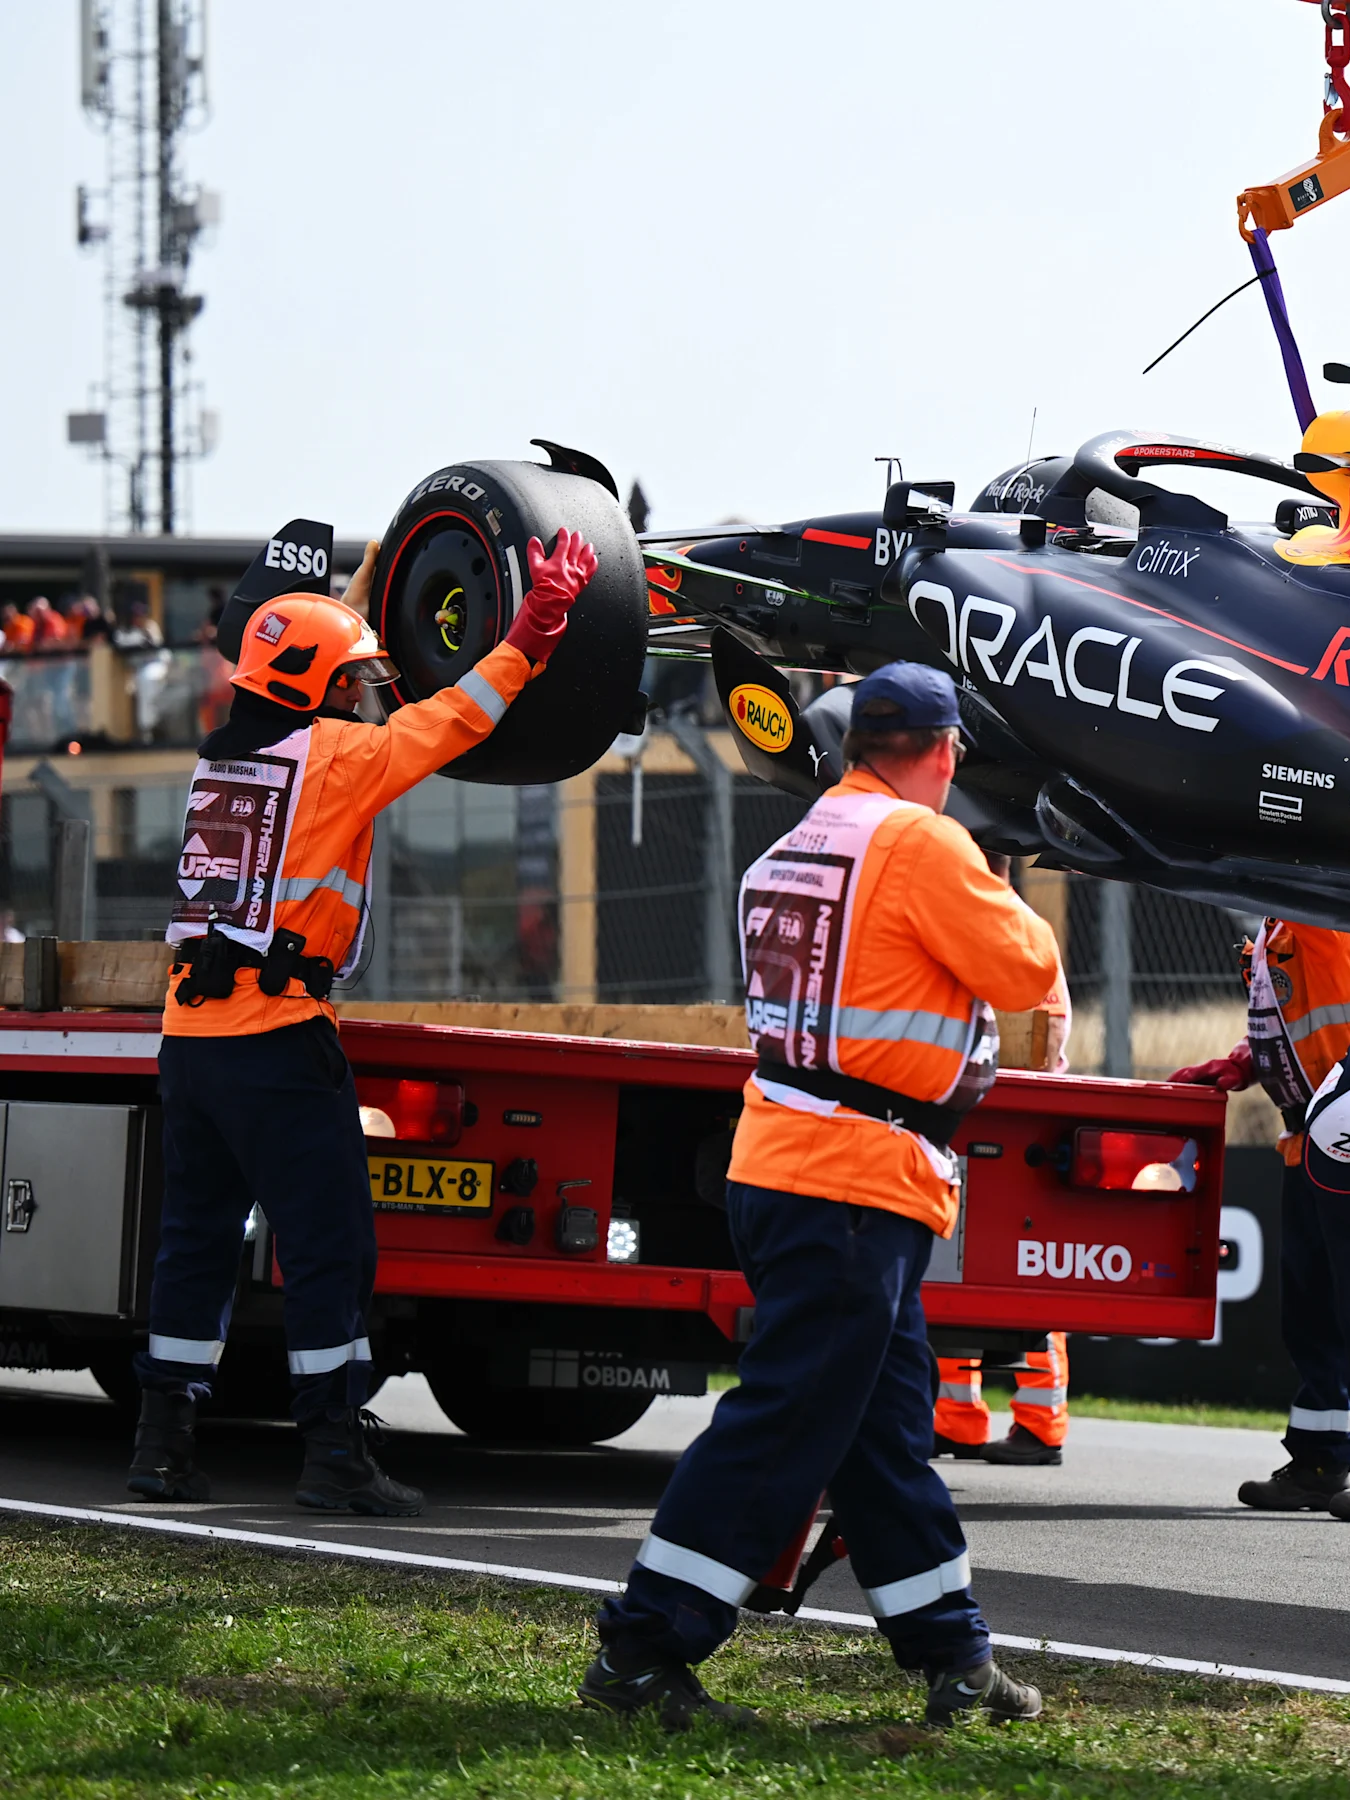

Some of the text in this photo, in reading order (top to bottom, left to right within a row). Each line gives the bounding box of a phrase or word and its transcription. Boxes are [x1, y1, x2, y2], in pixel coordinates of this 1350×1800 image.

[1139, 447, 1196, 459] POKERSTARS
[410, 474, 486, 505] ZERO
[1014, 482, 1045, 503] Rock
[265, 539, 328, 578] ESSO
[874, 527, 913, 567] BY
[1136, 540, 1201, 578] citrix
[907, 579, 1249, 733] ORACLE
[746, 699, 787, 742] RAUCH
[208, 762, 258, 777] RADIO MARSHAL
[1261, 762, 1336, 790] SIEMENS
[230, 797, 254, 816] FIA
[1258, 807, 1302, 822] Hewlett Packard
[1258, 813, 1287, 825] Enterprise
[177, 855, 240, 881] URSE
[245, 790, 280, 928] NETHERLANDS
[778, 914, 802, 941] FIA
[801, 904, 833, 1071] NETHERLAN
[1326, 1146, 1339, 1155] LE
[371, 1163, 478, 1201] -BLX-8
[1016, 1238, 1133, 1283] BUKO
[582, 1364, 671, 1390] OBDAM
